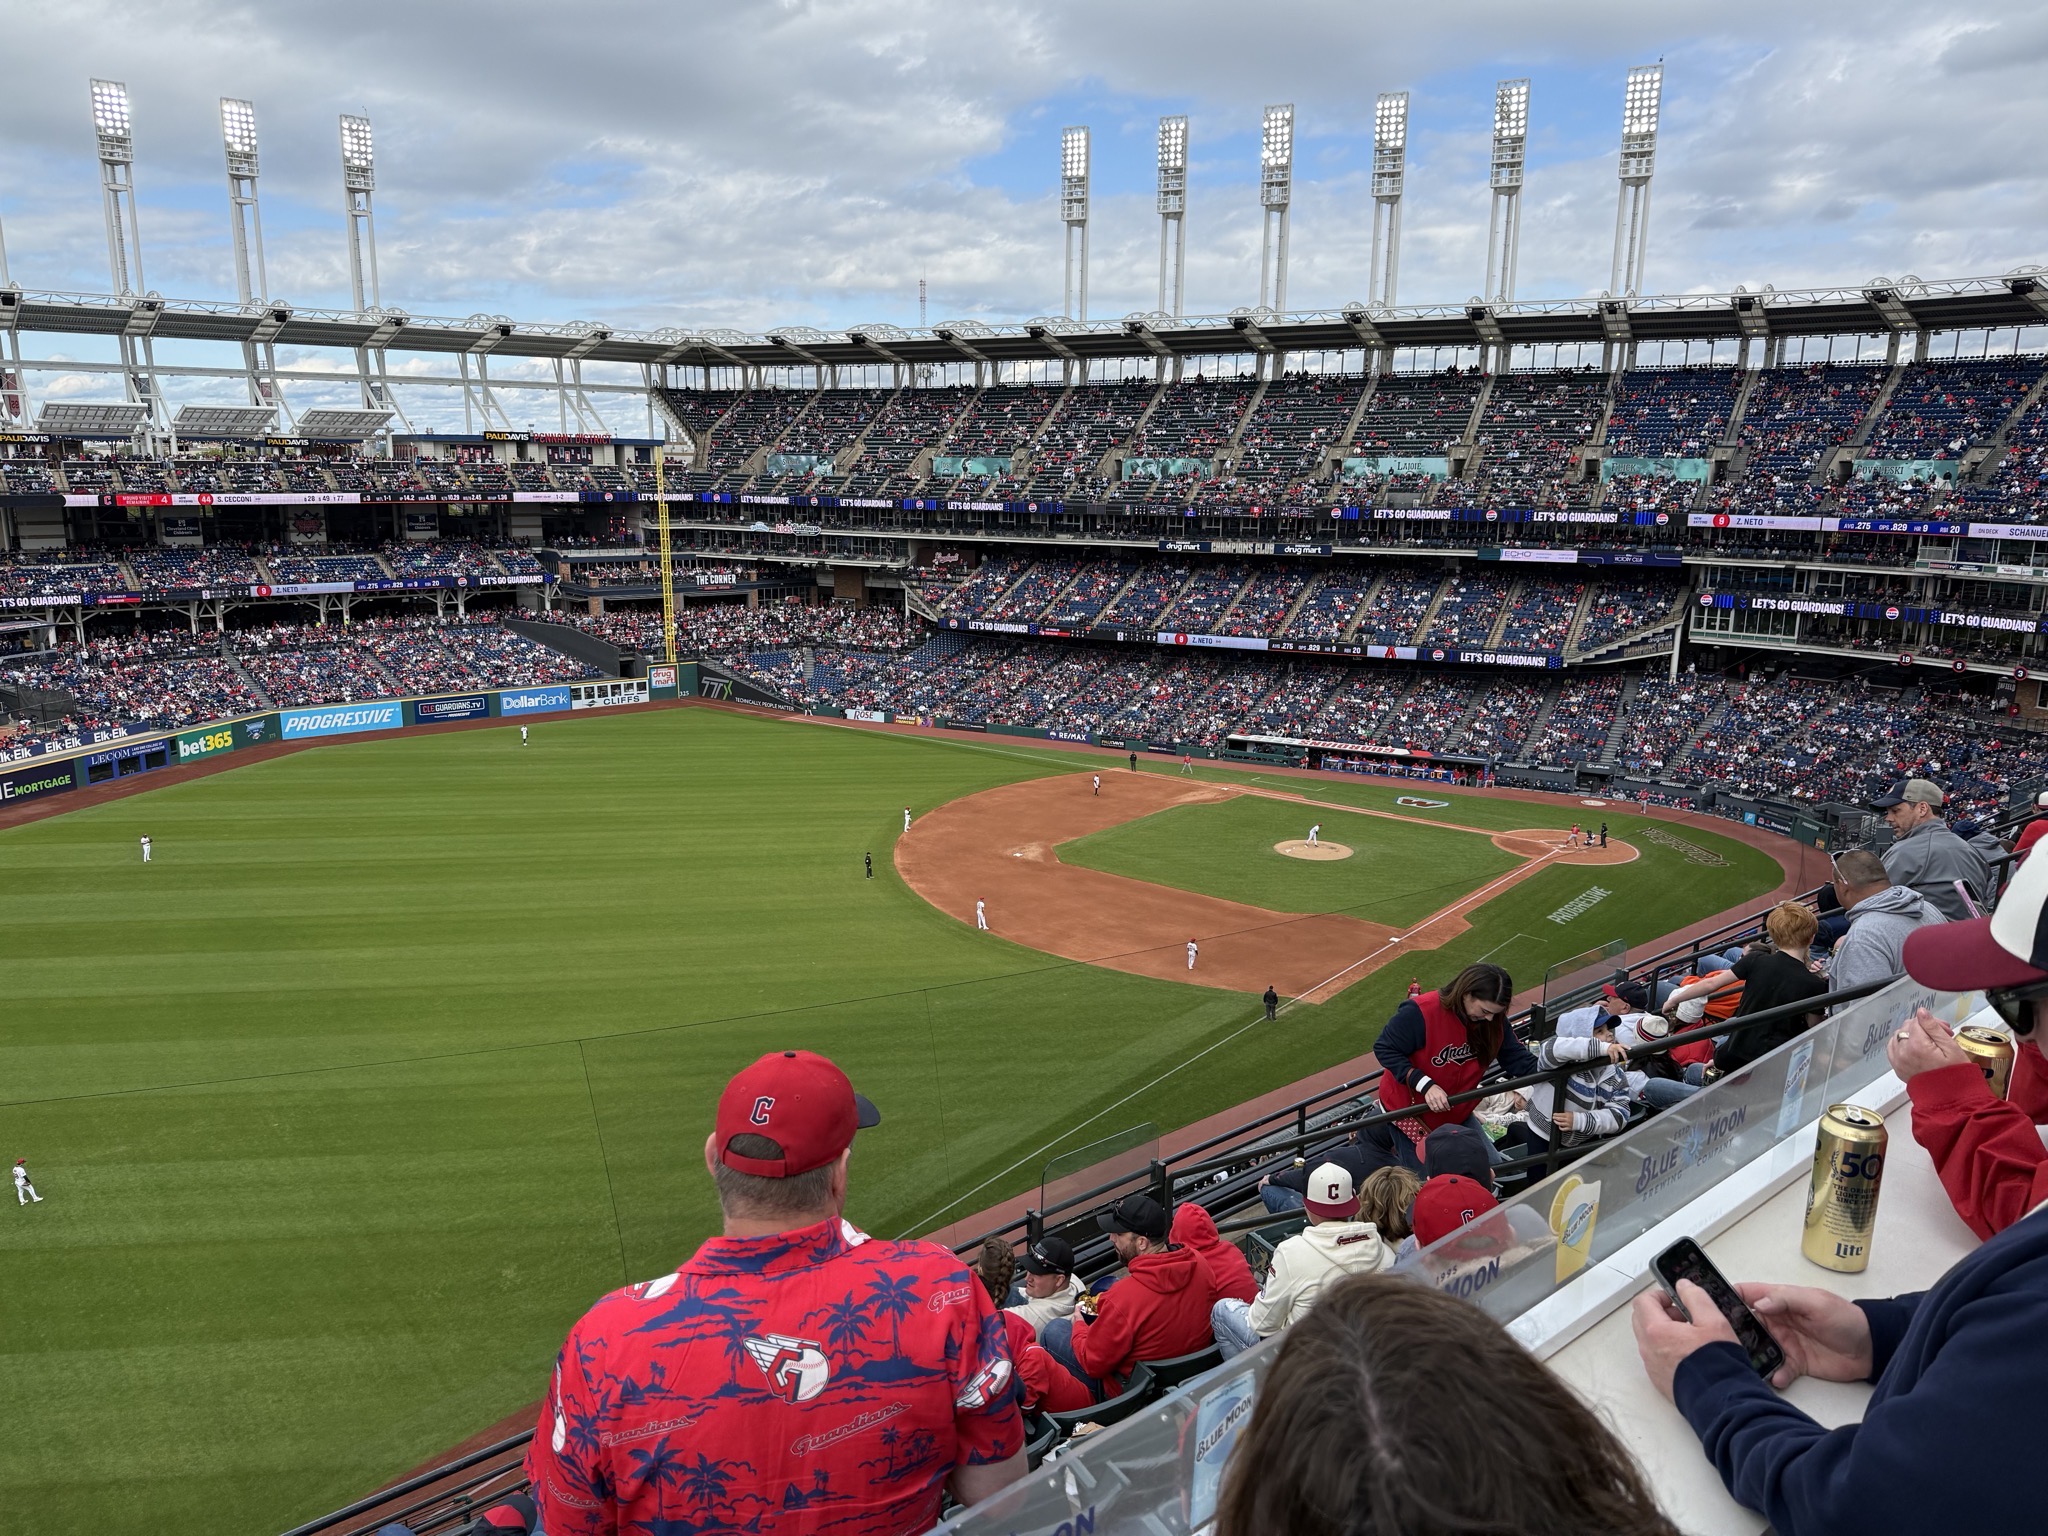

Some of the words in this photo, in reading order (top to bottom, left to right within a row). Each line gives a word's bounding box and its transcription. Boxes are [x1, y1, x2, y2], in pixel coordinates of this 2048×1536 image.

[533, 433, 574, 444] PENNANT
[576, 434, 612, 444] DISTRICT
[160, 496, 168, 504] 4
[761, 496, 790, 504] GUARDIANS!
[840, 498, 854, 506] LET'S
[948, 502, 962, 510] LET'S
[971, 502, 1003, 511] GUARDIANS!
[1374, 509, 1394, 518] LET'S
[1394, 510, 1405, 518] GO
[1406, 510, 1451, 520] GUARDIANS!
[1533, 511, 1555, 522] LET'S
[1556, 512, 1568, 522] GO
[1569, 512, 1618, 523] GUARDIANS!
[1744, 518, 1763, 526] NETO
[1855, 522, 1871, 530] .275
[1950, 526, 1960, 534] 20
[1166, 542, 1182, 552] drug
[1212, 542, 1253, 554] CHAMPIONS
[1255, 543, 1274, 554] CLUB
[1284, 545, 1302, 555] drug
[1304, 546, 1321, 554] mart
[507, 575, 543, 584] GUARDIANS!
[696, 575, 709, 585] THE
[710, 574, 737, 584] CORNER
[0, 598, 16, 608] ET'S
[16, 598, 30, 607] GO
[30, 595, 82, 606] GUARDIANS!
[1752, 598, 1776, 609] LET'S
[1777, 600, 1790, 610] GO
[1791, 600, 1844, 615] GUARDIANS!
[969, 621, 984, 630] LET'S
[985, 622, 993, 631] GO
[994, 623, 1028, 633] GUARDIANS!
[1940, 612, 1965, 625] LET'S
[1966, 616, 1980, 626] GO
[1981, 617, 2037, 633] GUARDIANS!
[1198, 637, 1213, 645] NETO
[1460, 652, 1482, 662] LET'S
[1484, 654, 1495, 663] GO
[1496, 654, 1546, 666] GUARDIANS!
[653, 668, 672, 678] drug
[655, 676, 676, 685] mart
[603, 695, 640, 706] CLIFFS
[778, 703, 795, 712] MATTER
[284, 708, 394, 732] PROGRESSIVE
[854, 710, 874, 719] ROSE
[1059, 732, 1086, 741] RE/MAX
[179, 730, 233, 758] bet365
[15, 775, 72, 796] MORTGAGE
[1546, 885, 1613, 925] PROGRESSIVE
[1863, 1019, 1892, 1055] BLUE
[750, 1096, 775, 1125] C
[1674, 1125, 1690, 1140] ESTD
[1636, 1146, 1679, 1194] BLUE
[1707, 1105, 1746, 1145] MOON
[1642, 1170, 1682, 1202] BREWING
[1696, 1137, 1734, 1167] COMPANY
[1840, 1152, 1883, 1181] 50
[1328, 1184, 1339, 1200] C
[1832, 1183, 1848, 1191] THE
[1835, 1190, 1859, 1199] LIGHT
[1836, 1196, 1858, 1205] SINCE
[1562, 1222, 1579, 1244] BLUE
[1578, 1203, 1595, 1226] MOON
[1835, 1242, 1863, 1259] Lite
[1436, 1264, 1458, 1285] 1995
[1444, 1256, 1501, 1298] MOON
[601, 1416, 697, 1447] Guardians
[790, 1402, 912, 1457] Guardians
[1196, 1426, 1224, 1463] BLUE
[1225, 1394, 1252, 1430] MOON
